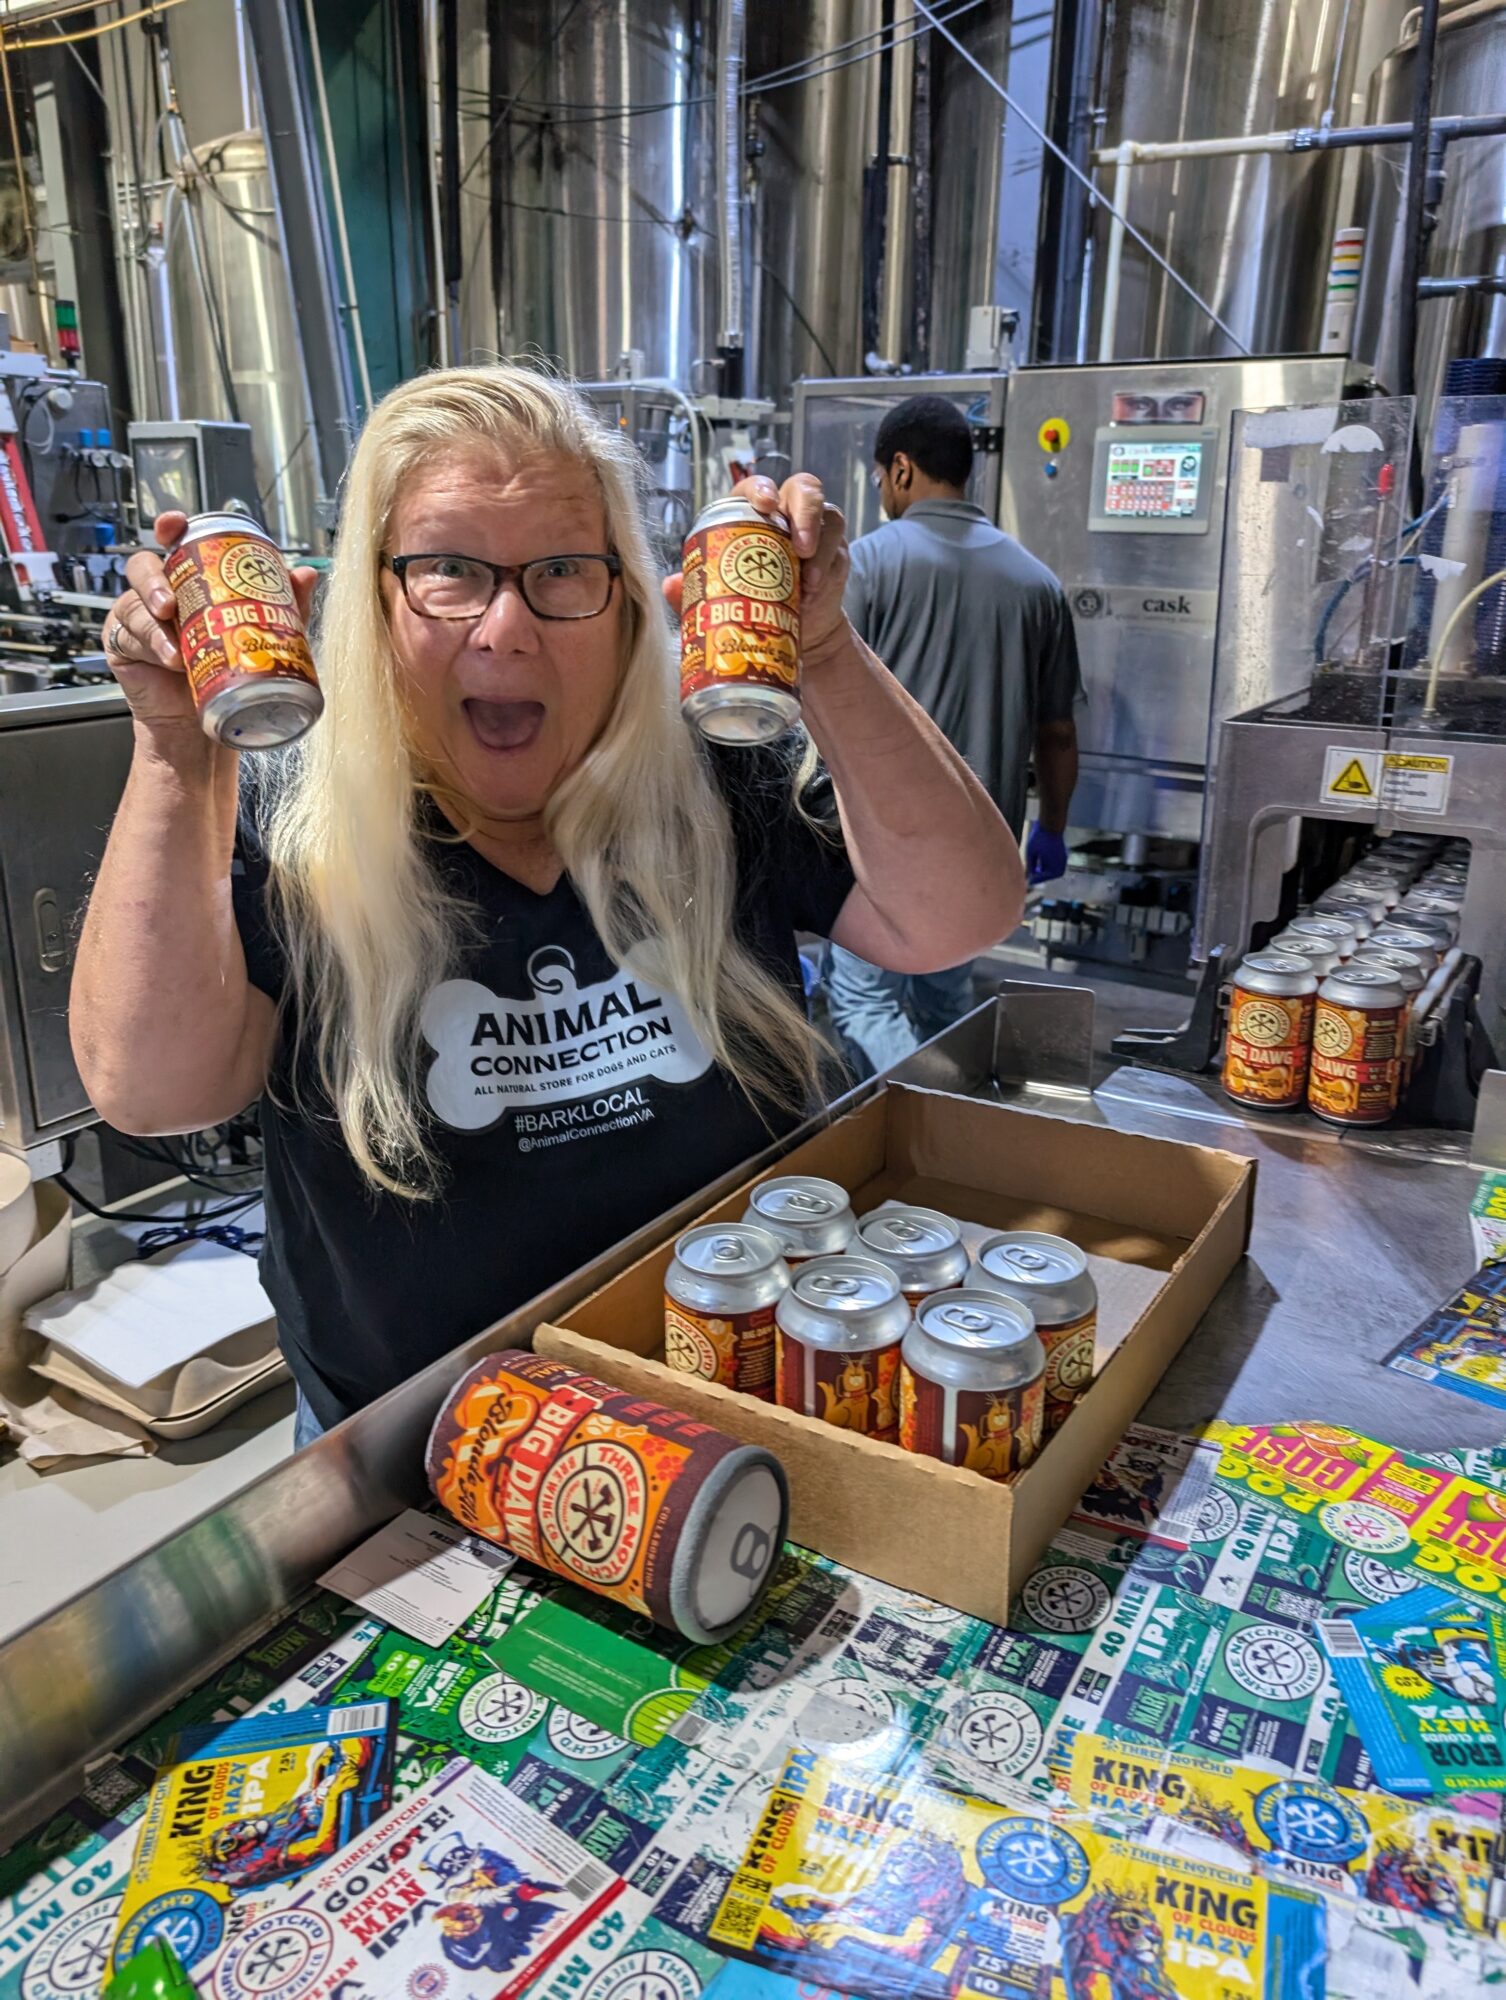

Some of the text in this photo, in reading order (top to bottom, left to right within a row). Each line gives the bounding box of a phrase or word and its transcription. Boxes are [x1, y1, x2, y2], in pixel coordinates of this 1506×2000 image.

[225, 546, 250, 582] THREE
[724, 537, 753, 576] THREE
[221, 604, 259, 628] BIG
[710, 601, 744, 625] BIG
[1142, 594, 1191, 614] cask
[470, 982, 662, 1047] ANIMAL
[470, 1016, 673, 1077] CONNECTION
[1251, 1048, 1294, 1066] DAWG
[474, 1043, 677, 1096] ALL NATURAL STORE FOR DOGS AND CATS
[1320, 1058, 1358, 1080] DAWG
[514, 1086, 650, 1133] #BARKLOCAL
[518, 1108, 655, 1152] @AnimalConnectionVA
[469, 1391, 513, 1487] Blonde
[520, 1402, 577, 1457] BIG
[542, 1455, 577, 1519] BREWING
[598, 1446, 641, 1517] THREE
[571, 1523, 637, 1579] NOTCH'D
[645, 1505, 671, 1589] COLLABORATION
[1231, 1539, 1256, 1562] 40
[1264, 1518, 1300, 1563] IPA
[1031, 1568, 1092, 1591] NOTCH'D
[1027, 1595, 1064, 1631] THREE
[1100, 1581, 1150, 1658] 40 MILE
[1135, 1606, 1181, 1659] IPA
[1002, 1641, 1032, 1676] IPA
[1231, 1657, 1281, 1698] THREE
[414, 1661, 461, 1708] IPA
[437, 1668, 477, 1716] 40 MILE
[474, 1708, 541, 1739] NOTCH'D
[1133, 1688, 1168, 1730] MARK
[1207, 1706, 1229, 1744] 40 MILE
[1408, 1705, 1486, 1719] IPA
[1418, 1719, 1491, 1733] HAZY
[1219, 1712, 1248, 1751] IPA
[1421, 1733, 1473, 1744] CLOUDS
[1121, 1744, 1235, 1777] THREE NOTCH'D
[1425, 1743, 1506, 1766] EROR
[207, 1761, 231, 1820] OF CLOUDS
[222, 1762, 248, 1815] HAZY
[240, 1756, 271, 1815] IPA
[558, 1787, 574, 1802] 40
[1090, 1780, 1108, 1792] OF
[1093, 1756, 1187, 1801] KING
[170, 1765, 216, 1839] KING
[746, 1798, 787, 1870] KING
[779, 1753, 819, 1793] IPA
[823, 1781, 915, 1831] KING
[1305, 1785, 1364, 1843] NOTCH'D
[332, 1797, 429, 1875] THREE NOTCH'D
[583, 1817, 622, 1861] MAR
[760, 1801, 802, 1875] OF CLOUDS
[981, 1820, 1081, 1886] THREE NOTCH'D
[72, 1860, 113, 1896] 40
[645, 1851, 661, 1868] 40
[1131, 1848, 1254, 1887] THREE NOTCH'D
[1283, 1859, 1344, 1883] KING
[325, 1875, 370, 1912] GO
[338, 1867, 412, 1929] MINUTE
[351, 1878, 428, 1946] MAN
[991, 1900, 1050, 1924] KING
[1155, 1875, 1259, 1930] KING
[0, 1899, 64, 1955] MIL
[119, 1894, 195, 1954] NOTCH'D
[244, 1914, 325, 1943] NOTCH'D
[367, 1899, 442, 1959] IPA
[588, 1910, 625, 1950] 40
[1173, 1911, 1259, 1944] OF CLOUDS
[1173, 1925, 1255, 1960] HAZY
[325, 1957, 359, 1986] MAN
[975, 1976, 1000, 1991] 10
[1166, 1939, 1255, 1985] IPA
